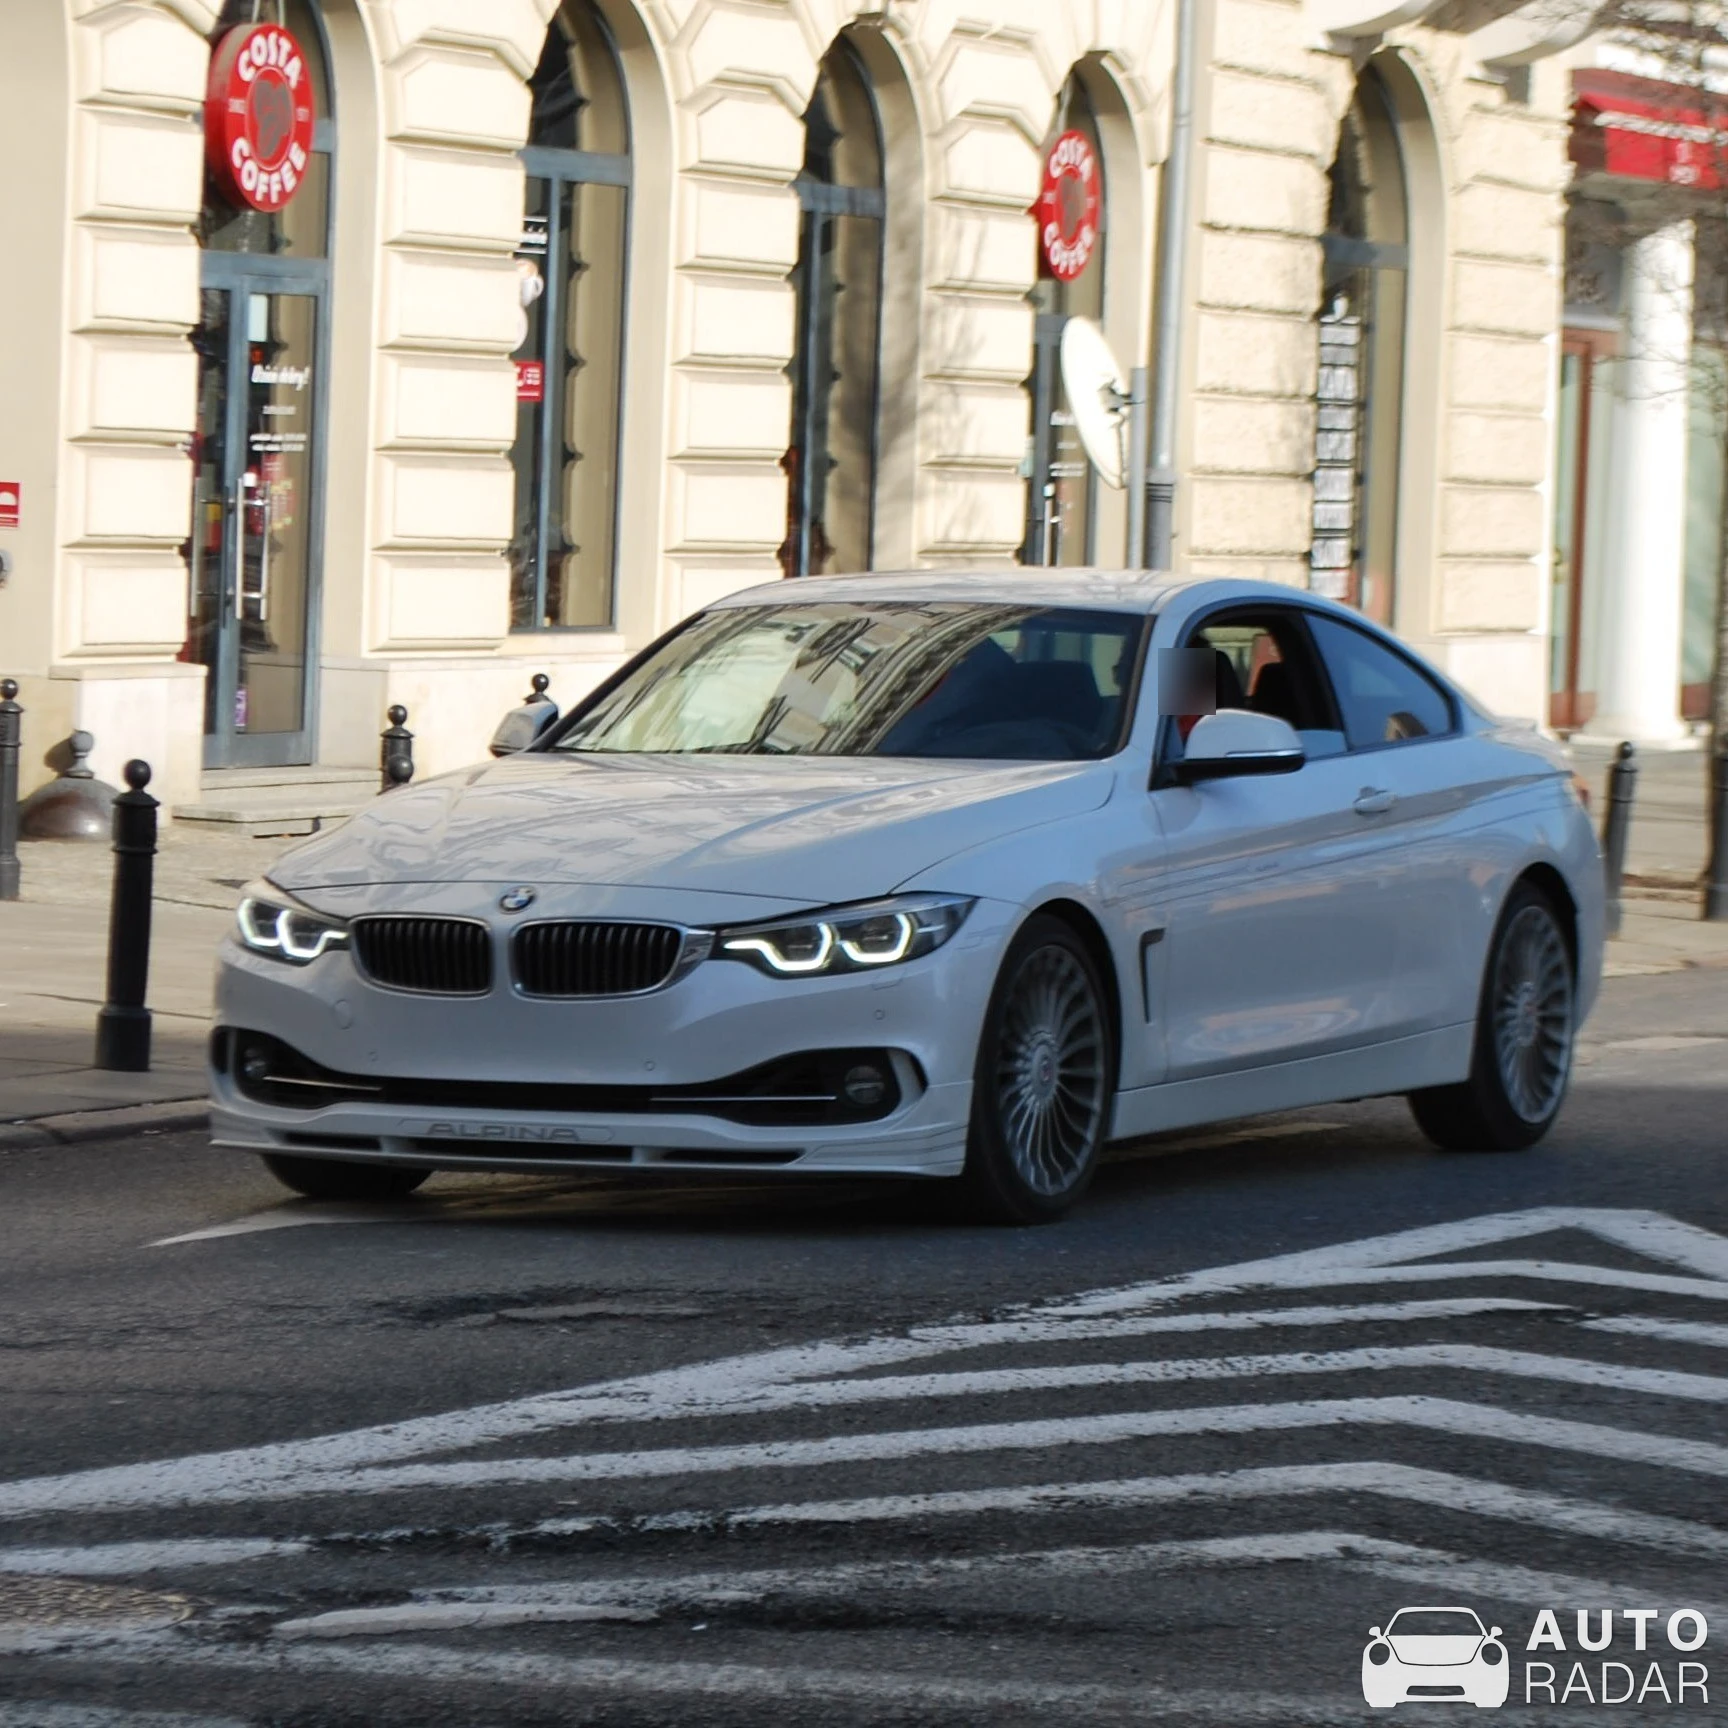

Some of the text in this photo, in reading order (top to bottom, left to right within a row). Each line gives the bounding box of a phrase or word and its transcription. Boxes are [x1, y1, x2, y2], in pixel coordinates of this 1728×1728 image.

[238, 31, 303, 90] COSTA
[232, 137, 306, 203] COFFEE
[426, 1122, 580, 1142] ALPINA
